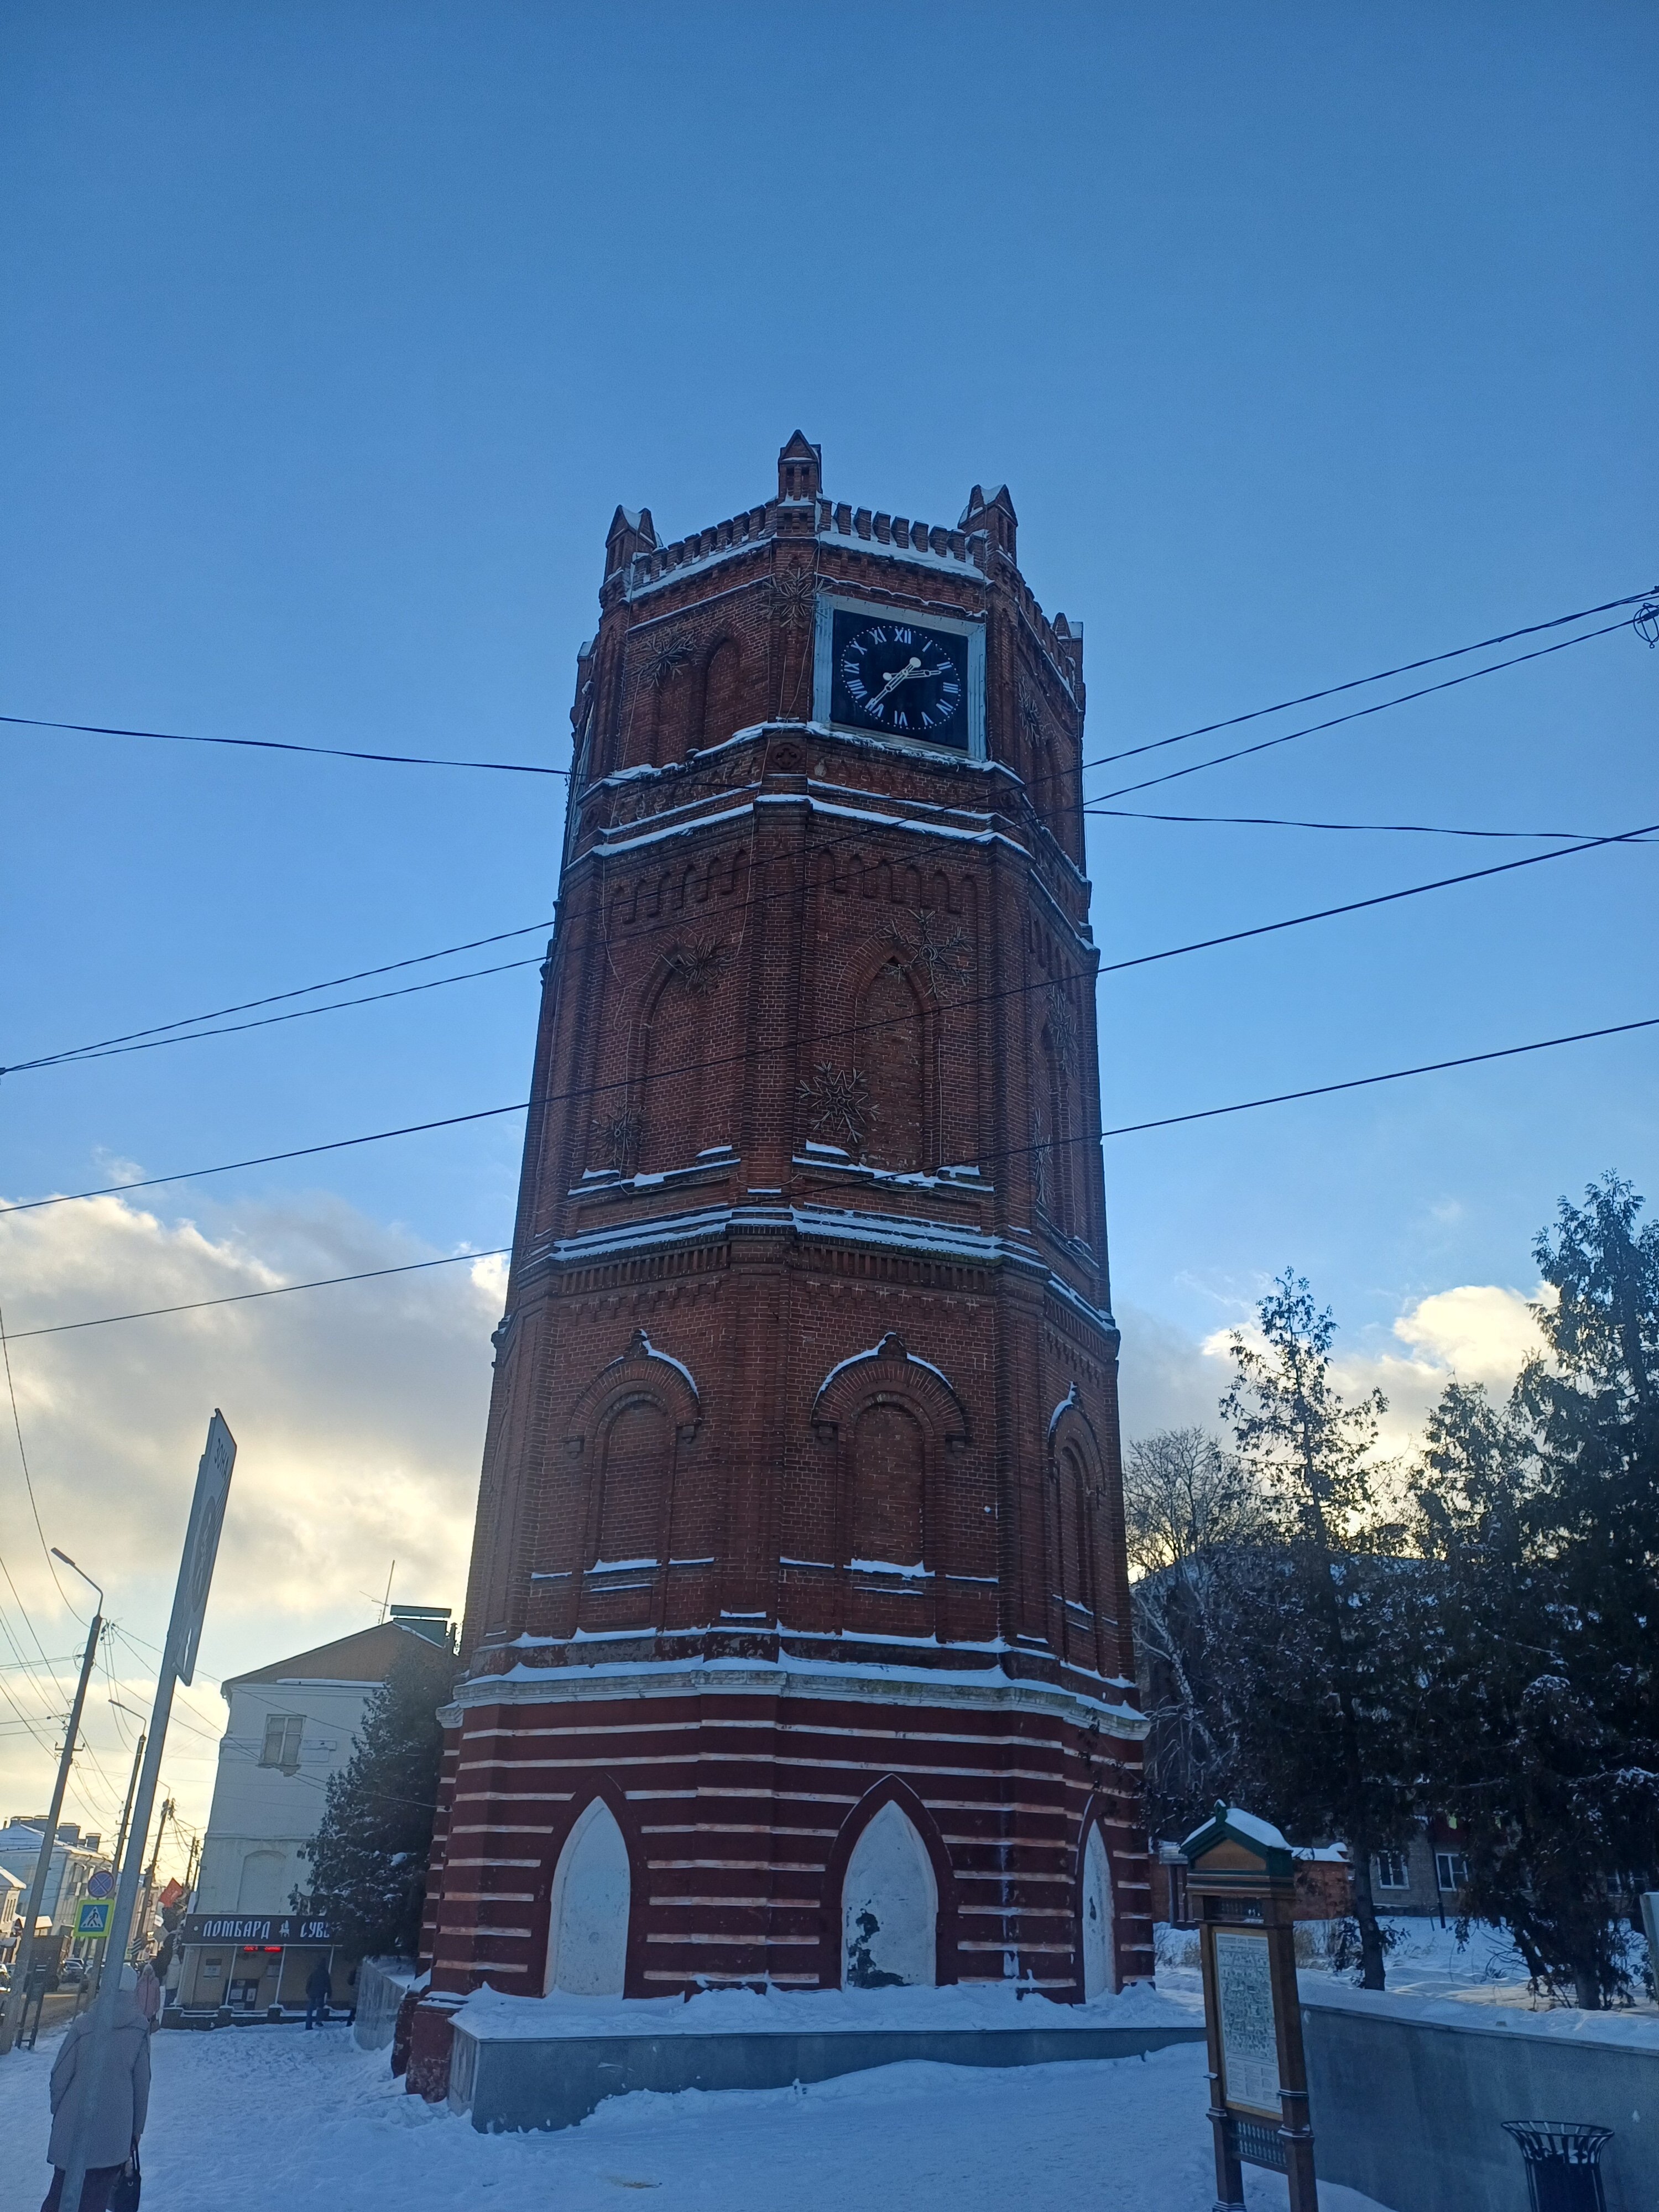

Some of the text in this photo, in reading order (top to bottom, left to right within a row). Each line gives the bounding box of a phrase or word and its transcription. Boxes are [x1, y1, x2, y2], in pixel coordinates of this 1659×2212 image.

[869, 627, 887, 645] XI
[894, 628, 911, 644] XII
[851, 640, 868, 655] X
[922, 641, 932, 652] I
[844, 660, 859, 674] IX
[937, 661, 952, 670] II
[847, 679, 868, 700] VIII
[943, 682, 958, 693] III
[936, 698, 954, 716] IV
[894, 711, 908, 726] VI
[921, 711, 934, 726] V
[214, 1437, 229, 1481] ЗОНА
[202, 1920, 271, 1939] ЛОМБАРД
